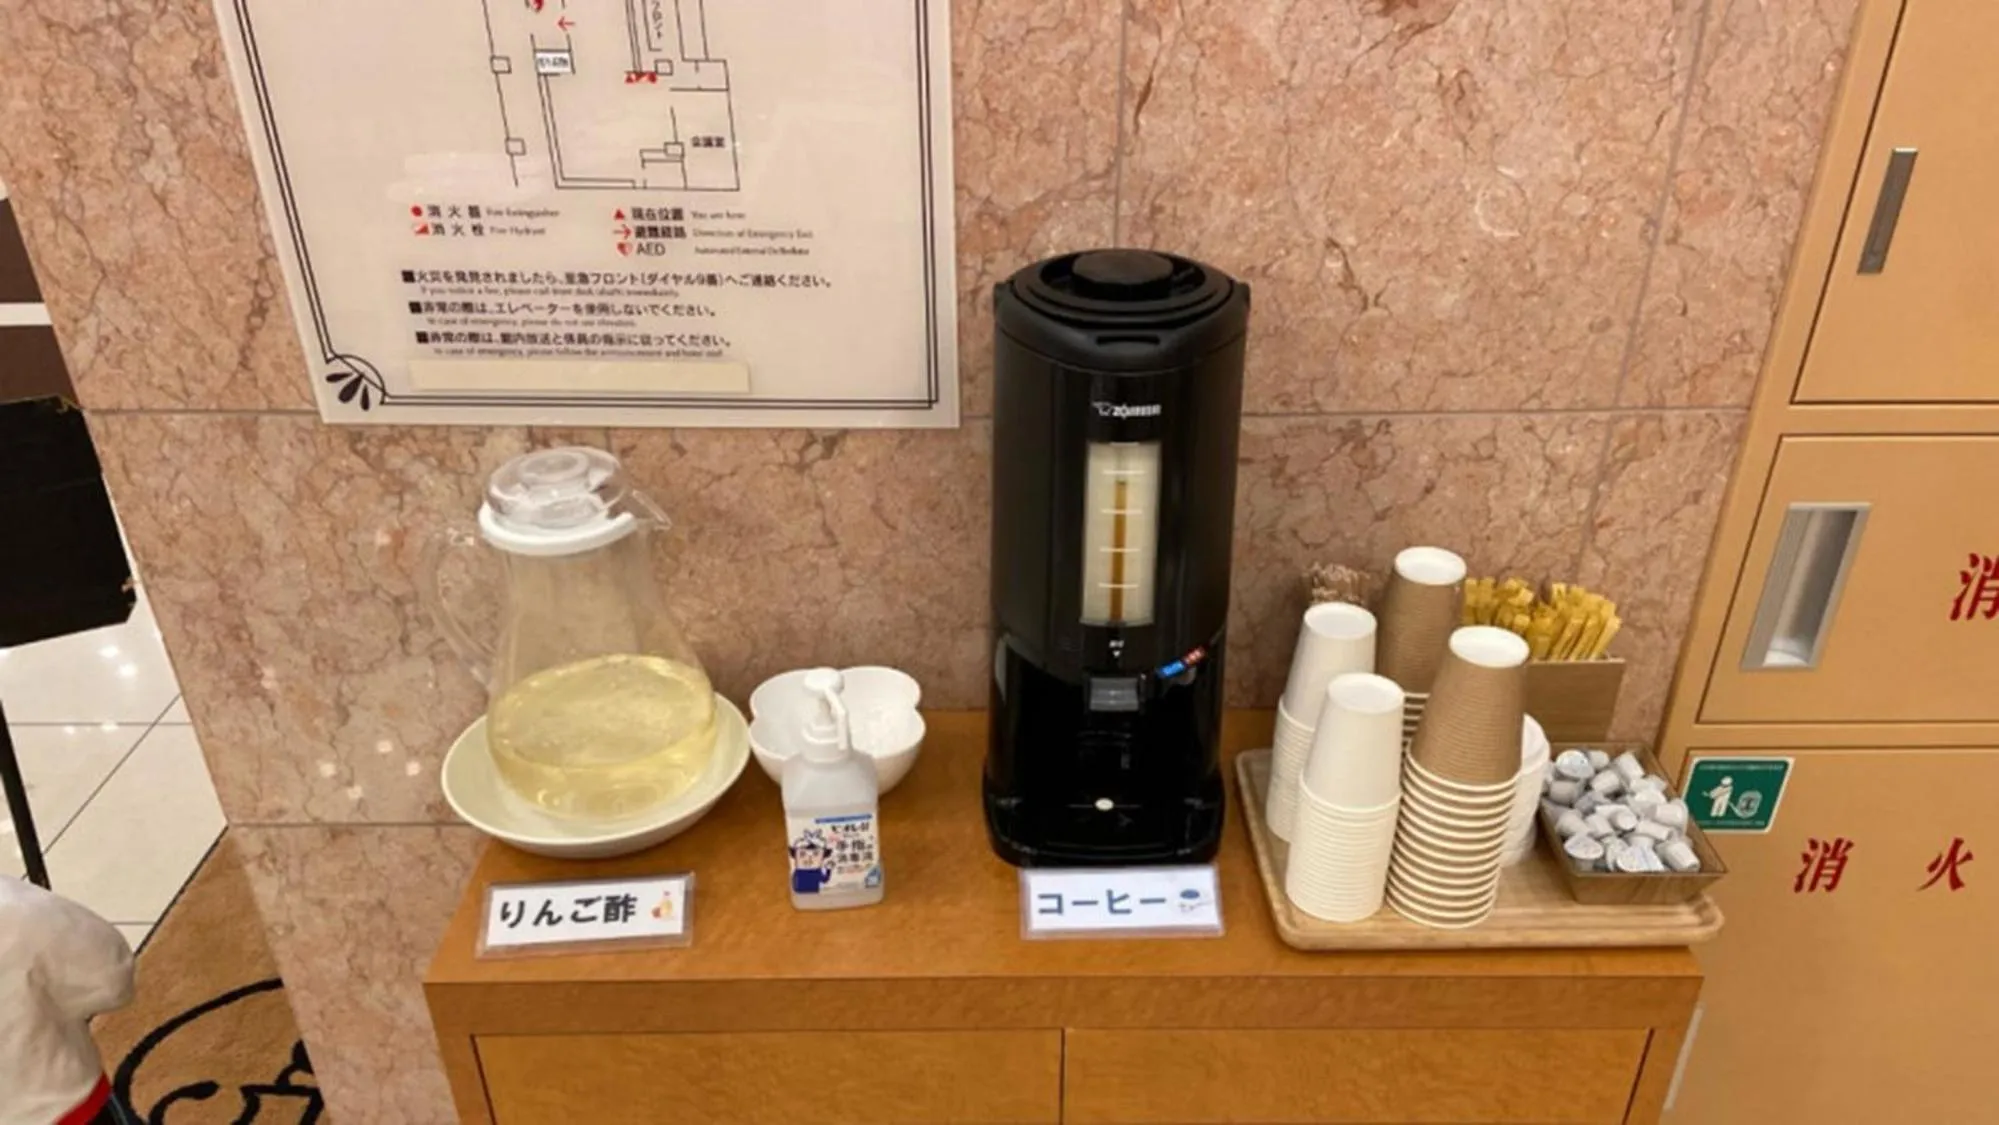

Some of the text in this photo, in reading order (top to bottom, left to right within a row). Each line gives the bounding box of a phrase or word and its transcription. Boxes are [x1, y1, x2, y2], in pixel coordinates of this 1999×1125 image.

[631, 207, 684, 220] 現在位置
[636, 243, 665, 256] AED
[500, 893, 638, 929] りんご酢
[1038, 889, 1167, 915] コーヒー
